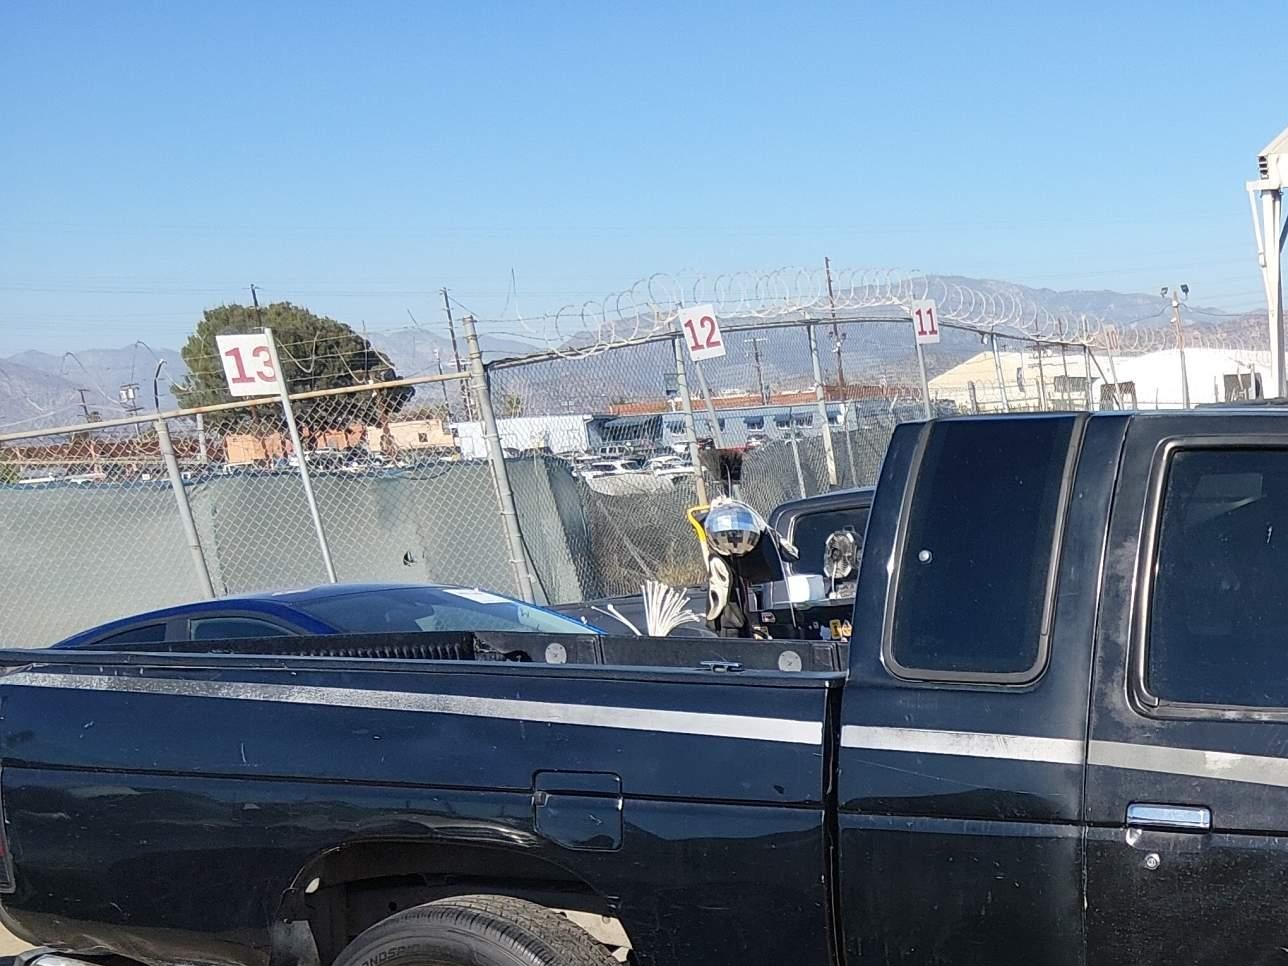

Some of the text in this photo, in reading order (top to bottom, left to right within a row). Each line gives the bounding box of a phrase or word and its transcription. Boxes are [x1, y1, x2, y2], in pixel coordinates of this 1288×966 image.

[684, 315, 722, 351] 12
[915, 307, 938, 336] 11
[225, 345, 278, 384] 13
